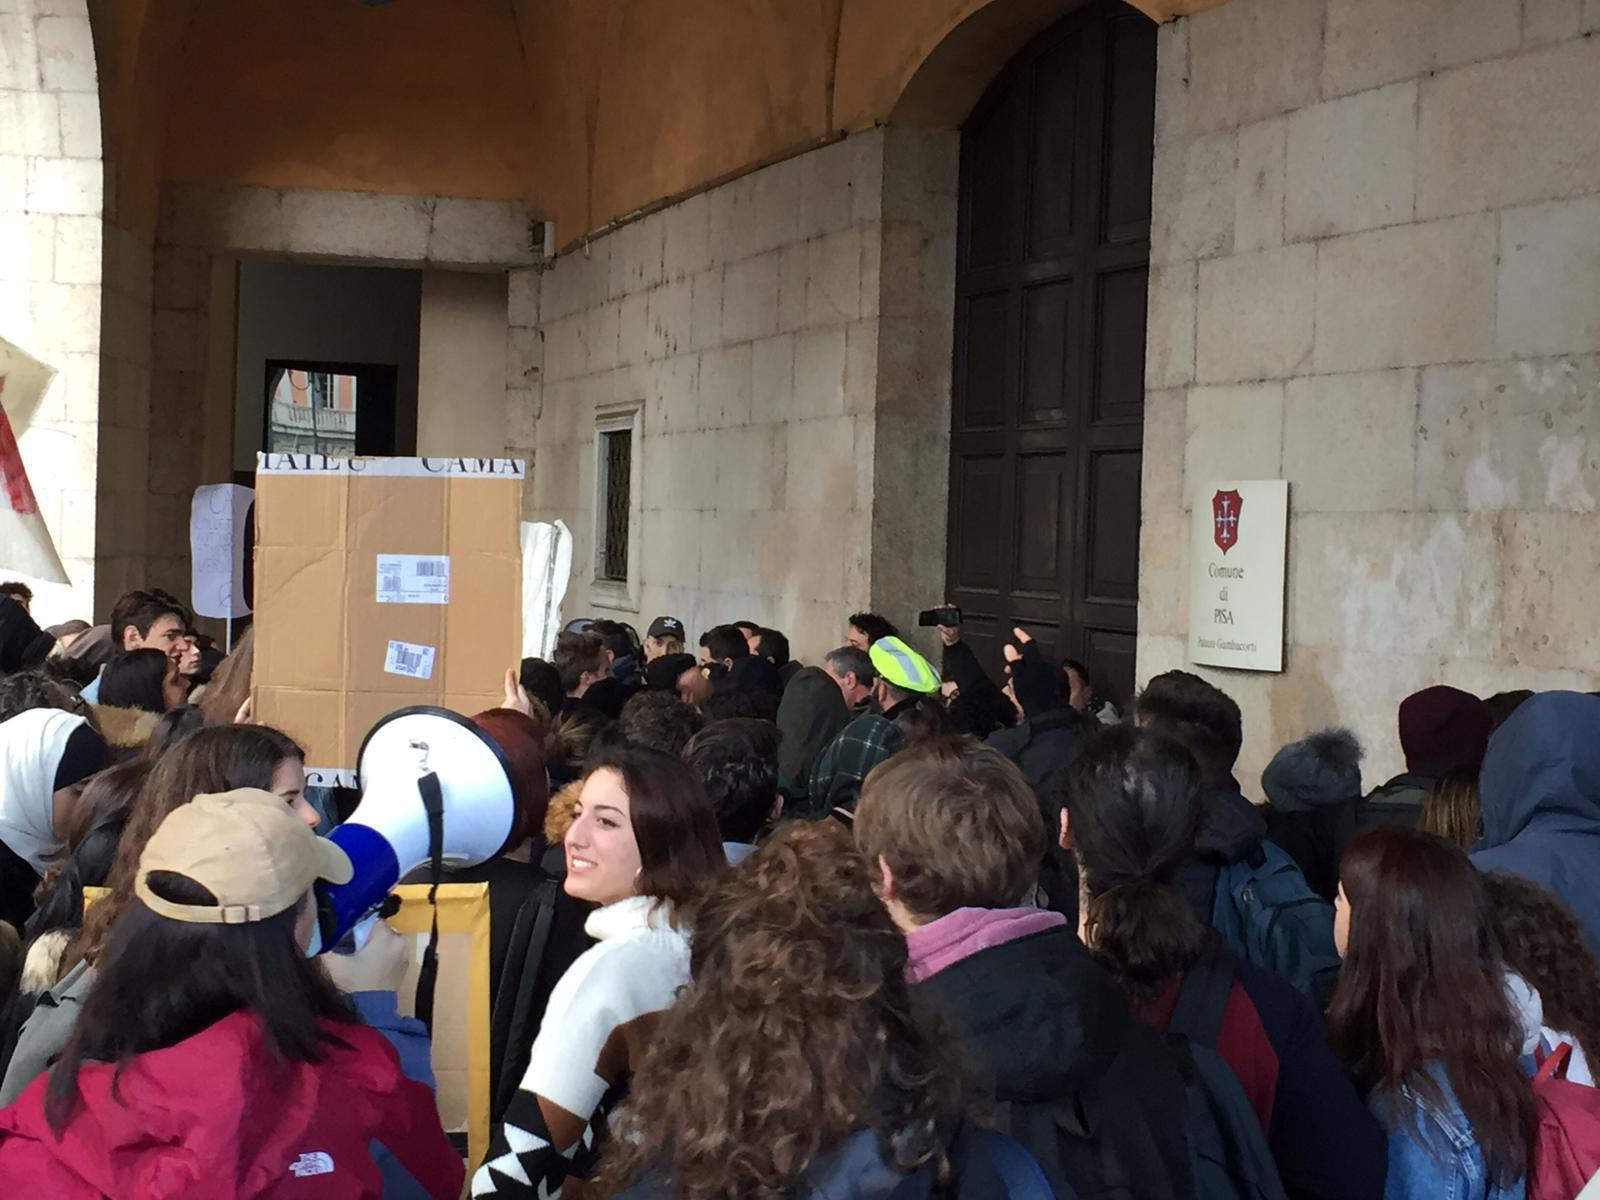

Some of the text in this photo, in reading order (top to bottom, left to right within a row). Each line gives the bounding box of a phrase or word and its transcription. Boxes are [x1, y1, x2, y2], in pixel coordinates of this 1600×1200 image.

[1208, 562, 1245, 579] Comune
[1219, 586, 1229, 601] di
[1214, 608, 1234, 625] PISA
